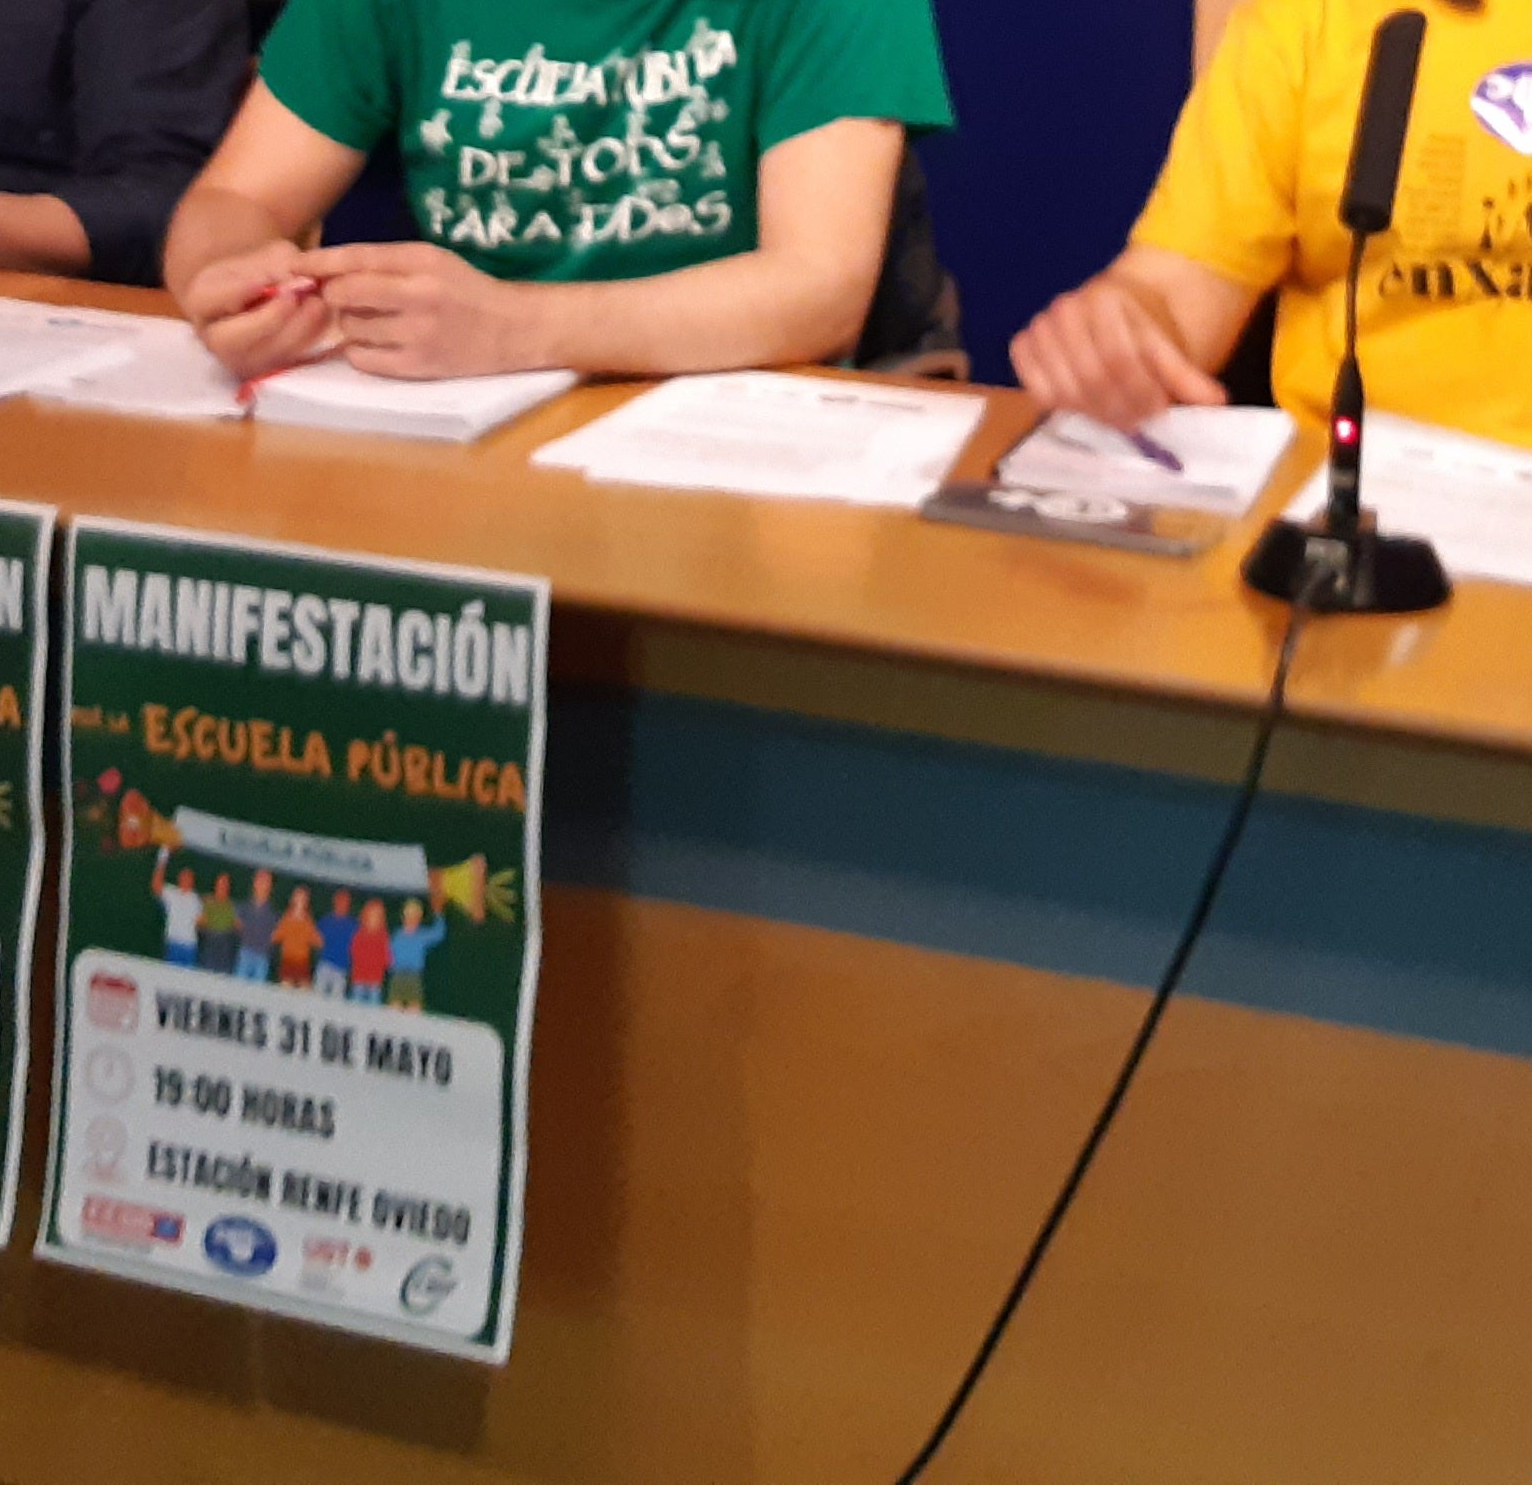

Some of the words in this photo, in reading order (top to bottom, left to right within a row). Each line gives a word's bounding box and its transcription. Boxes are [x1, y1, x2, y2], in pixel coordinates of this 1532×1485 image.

[82, 564, 530, 706] MANIFESTACIÓN
[141, 702, 333, 779] ESCUELA
[346, 730, 527, 813] PÚBLICA
[155, 1065, 232, 1117] 19:00
[241, 1081, 336, 1139] HORAS
[279, 1014, 310, 1057] 31
[321, 1021, 355, 1068] DE
[366, 1030, 453, 1086] MAYO
[147, 1139, 272, 1200] ESTACIÓN
[372, 1187, 472, 1246] OVIEDO
